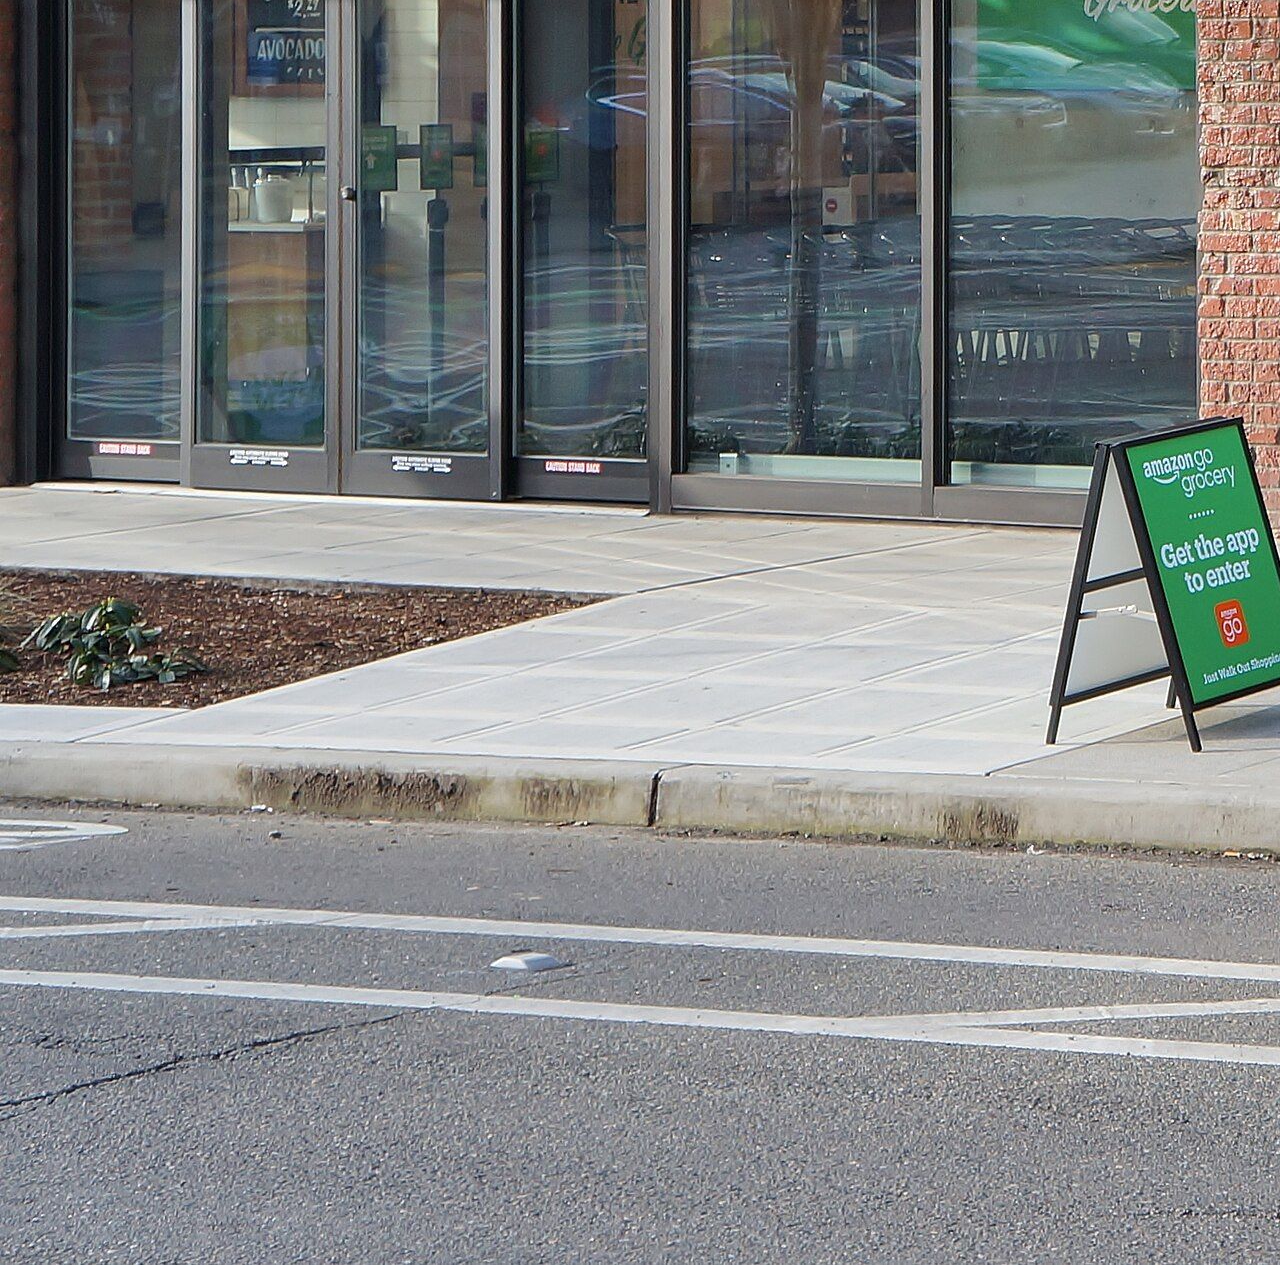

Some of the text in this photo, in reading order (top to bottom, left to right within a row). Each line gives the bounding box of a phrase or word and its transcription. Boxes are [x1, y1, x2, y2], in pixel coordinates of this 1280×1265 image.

[257, 38, 326, 61] AVOCADO
[1143, 448, 1213, 478] amazon go
[1181, 465, 1235, 498] grocery
[1161, 527, 1260, 569] Get the app
[1184, 559, 1251, 594] to enter
[1222, 617, 1243, 642] go
[1203, 671, 1219, 685] Just
[1217, 665, 1238, 680] Walk
[1236, 661, 1252, 675] Out
